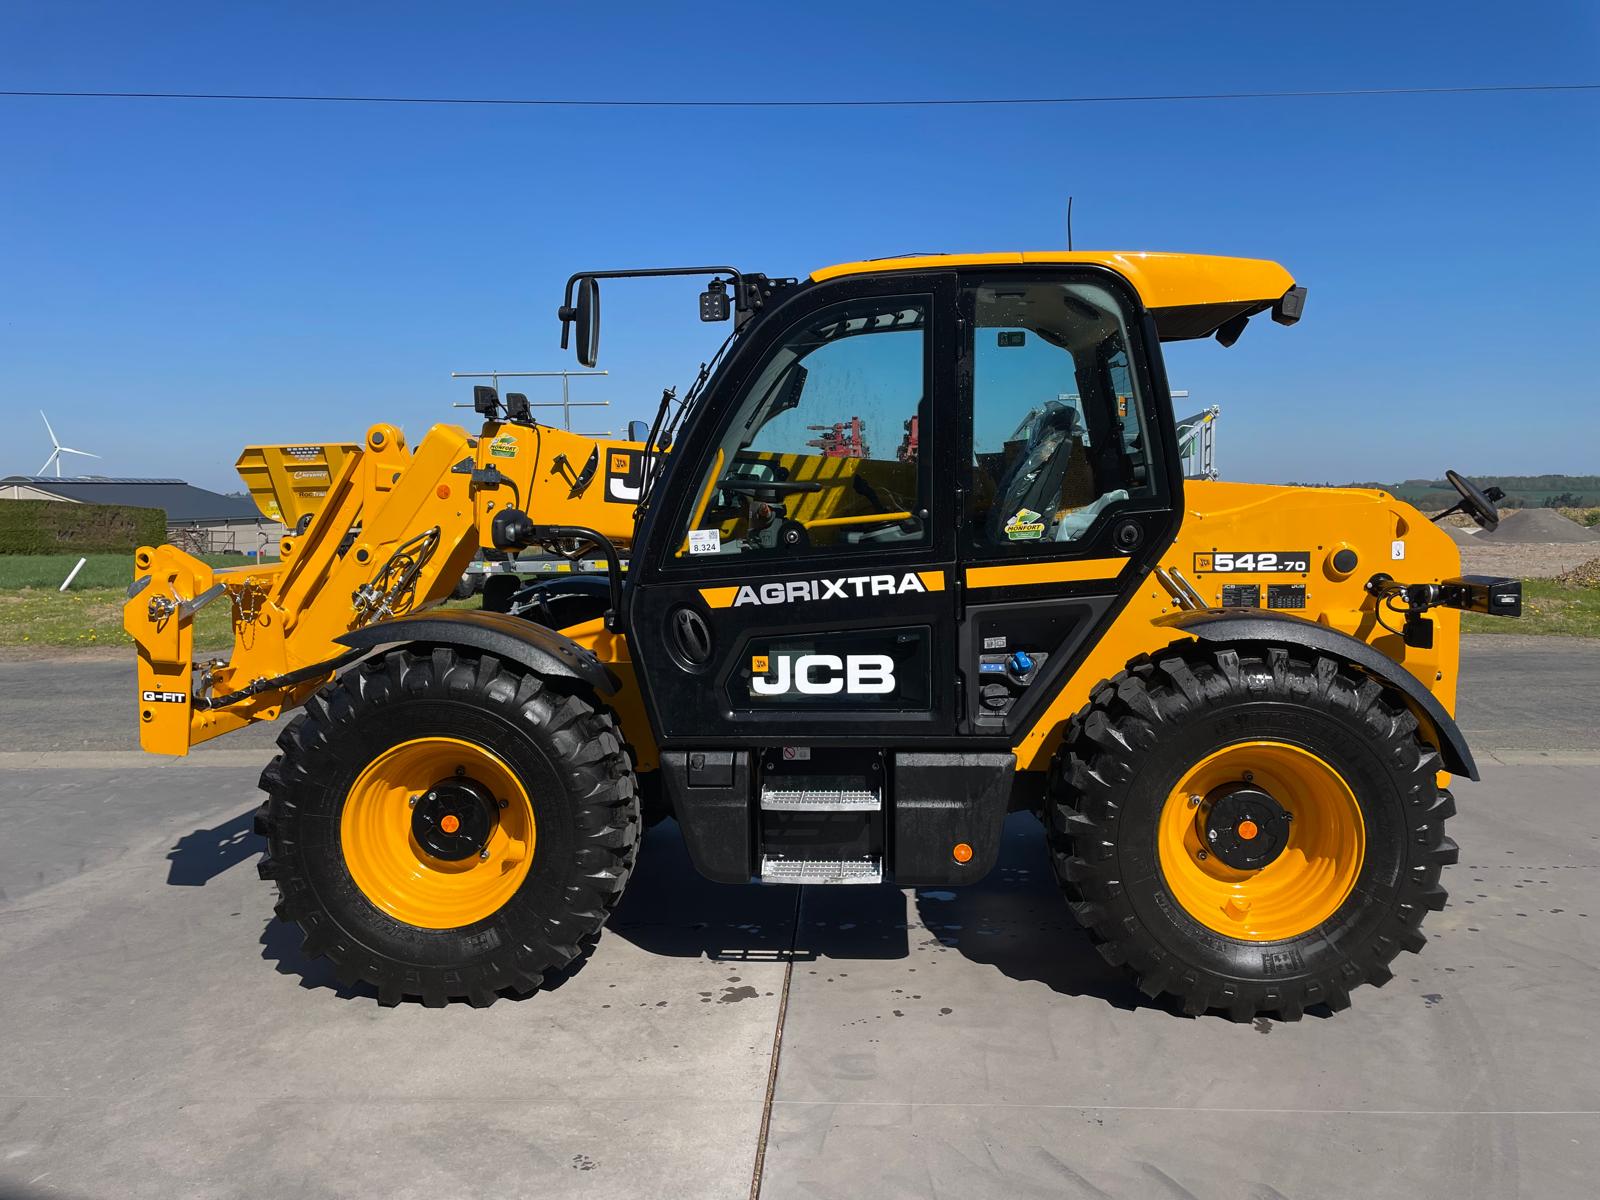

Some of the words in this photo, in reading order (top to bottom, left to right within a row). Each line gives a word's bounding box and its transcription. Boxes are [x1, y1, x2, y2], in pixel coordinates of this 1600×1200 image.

[694, 544, 716, 552] 8.324
[734, 573, 925, 607] AGRIXTRA
[752, 654, 896, 695] JCB
[143, 691, 185, 702] Q-FIT
